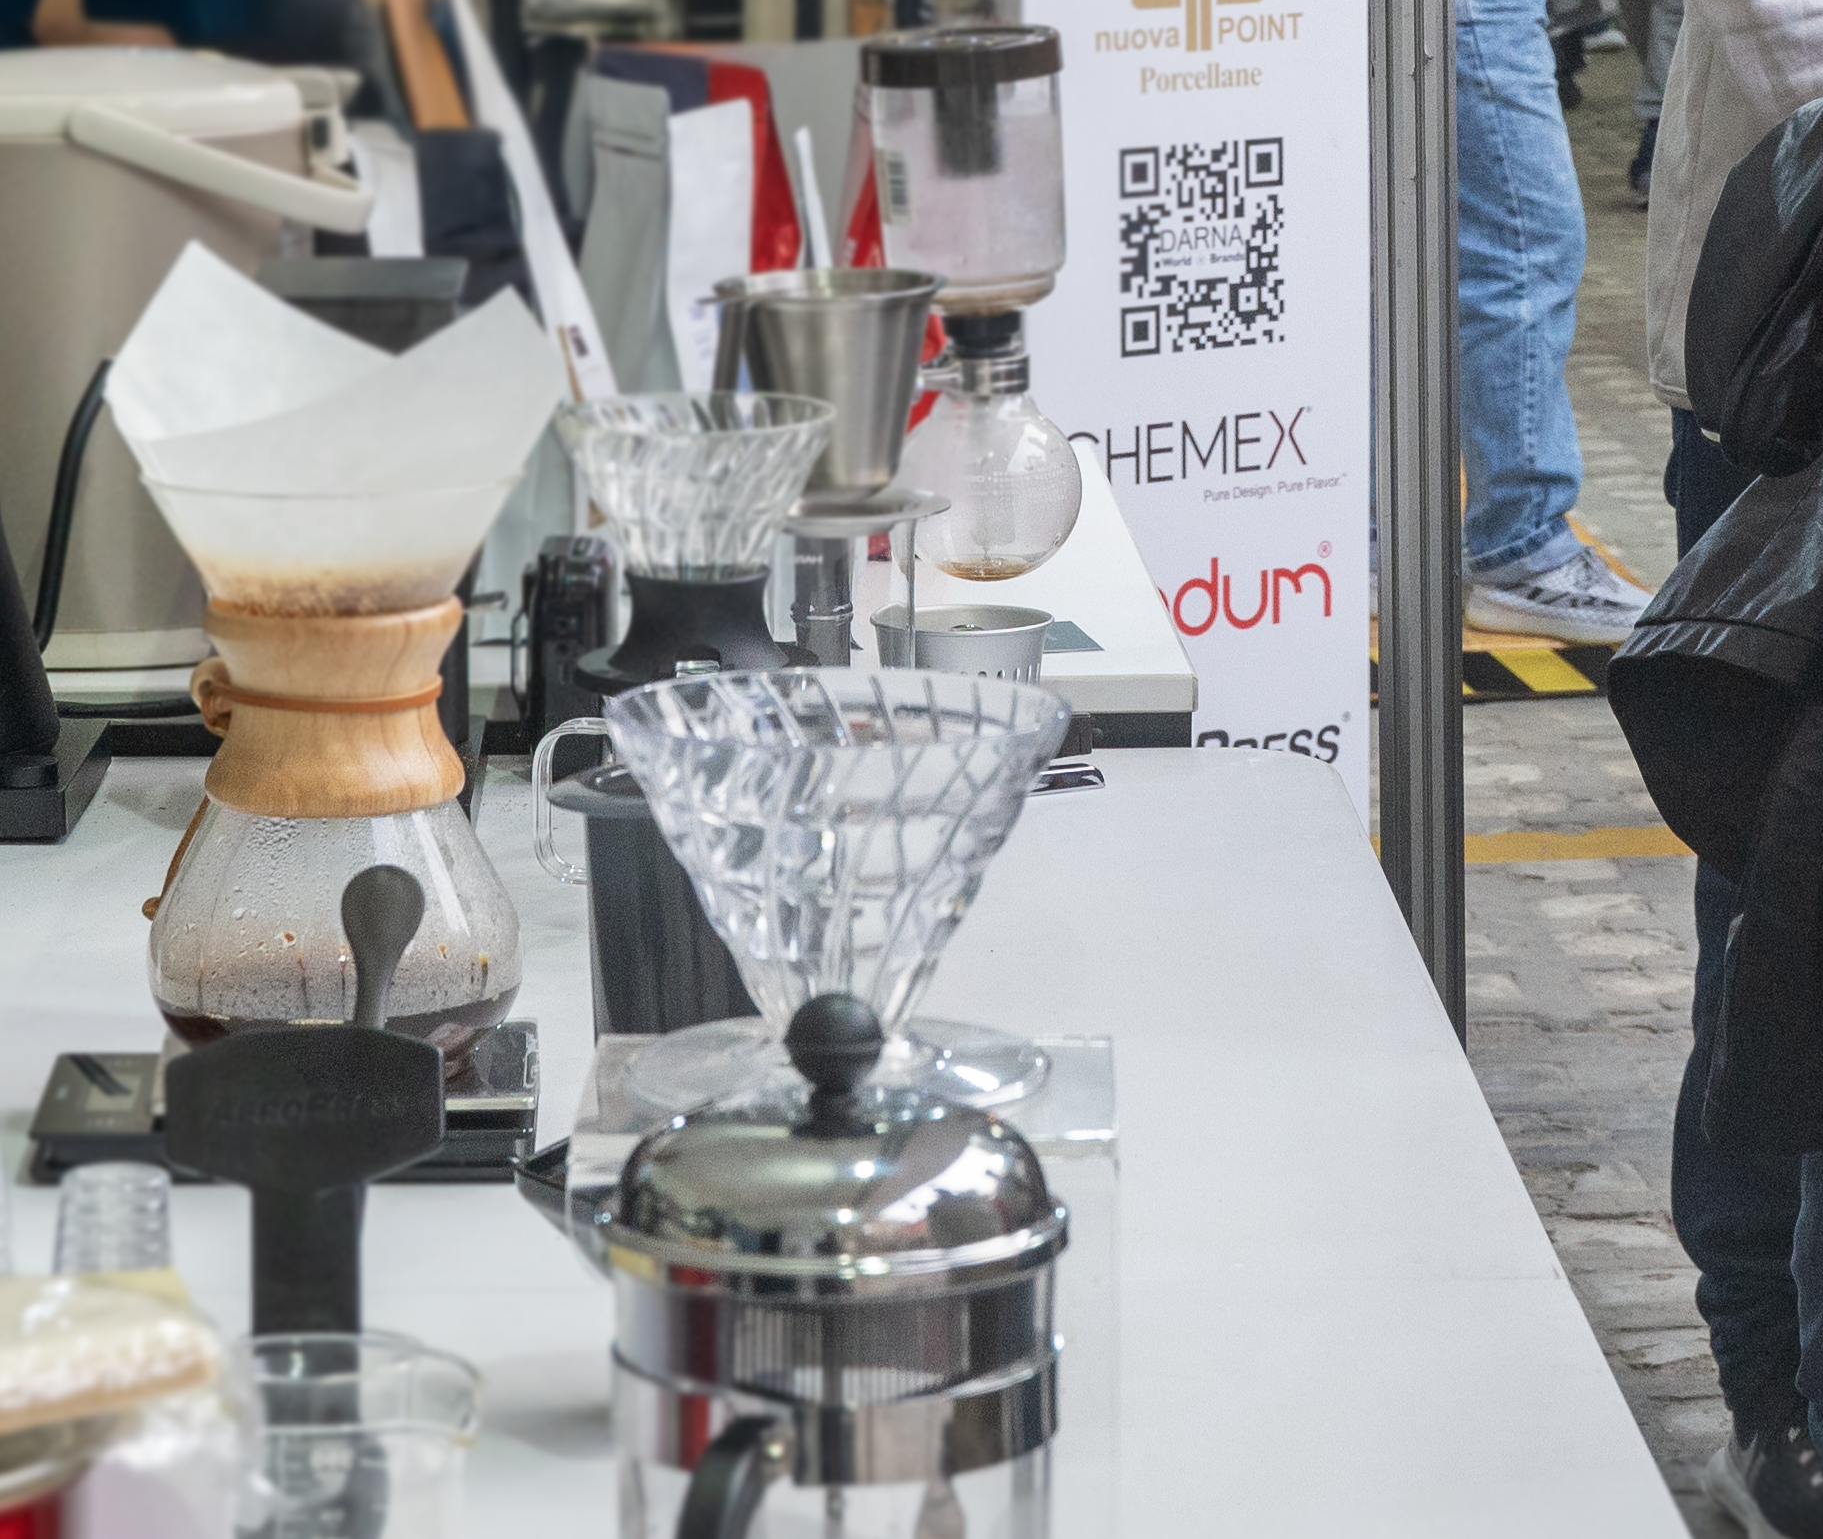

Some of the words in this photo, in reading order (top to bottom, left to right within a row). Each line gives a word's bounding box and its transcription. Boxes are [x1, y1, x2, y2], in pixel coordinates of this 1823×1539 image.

[1095, 23, 1180, 53] nuova
[1217, 12, 1305, 45] POINT
[1139, 62, 1263, 95] Porcellane
[1160, 224, 1245, 253] DARNA
[1161, 255, 1193, 268] World
[1210, 252, 1246, 265] Brands
[1203, 488, 1231, 503] Pure
[1276, 480, 1304, 493] Pure
